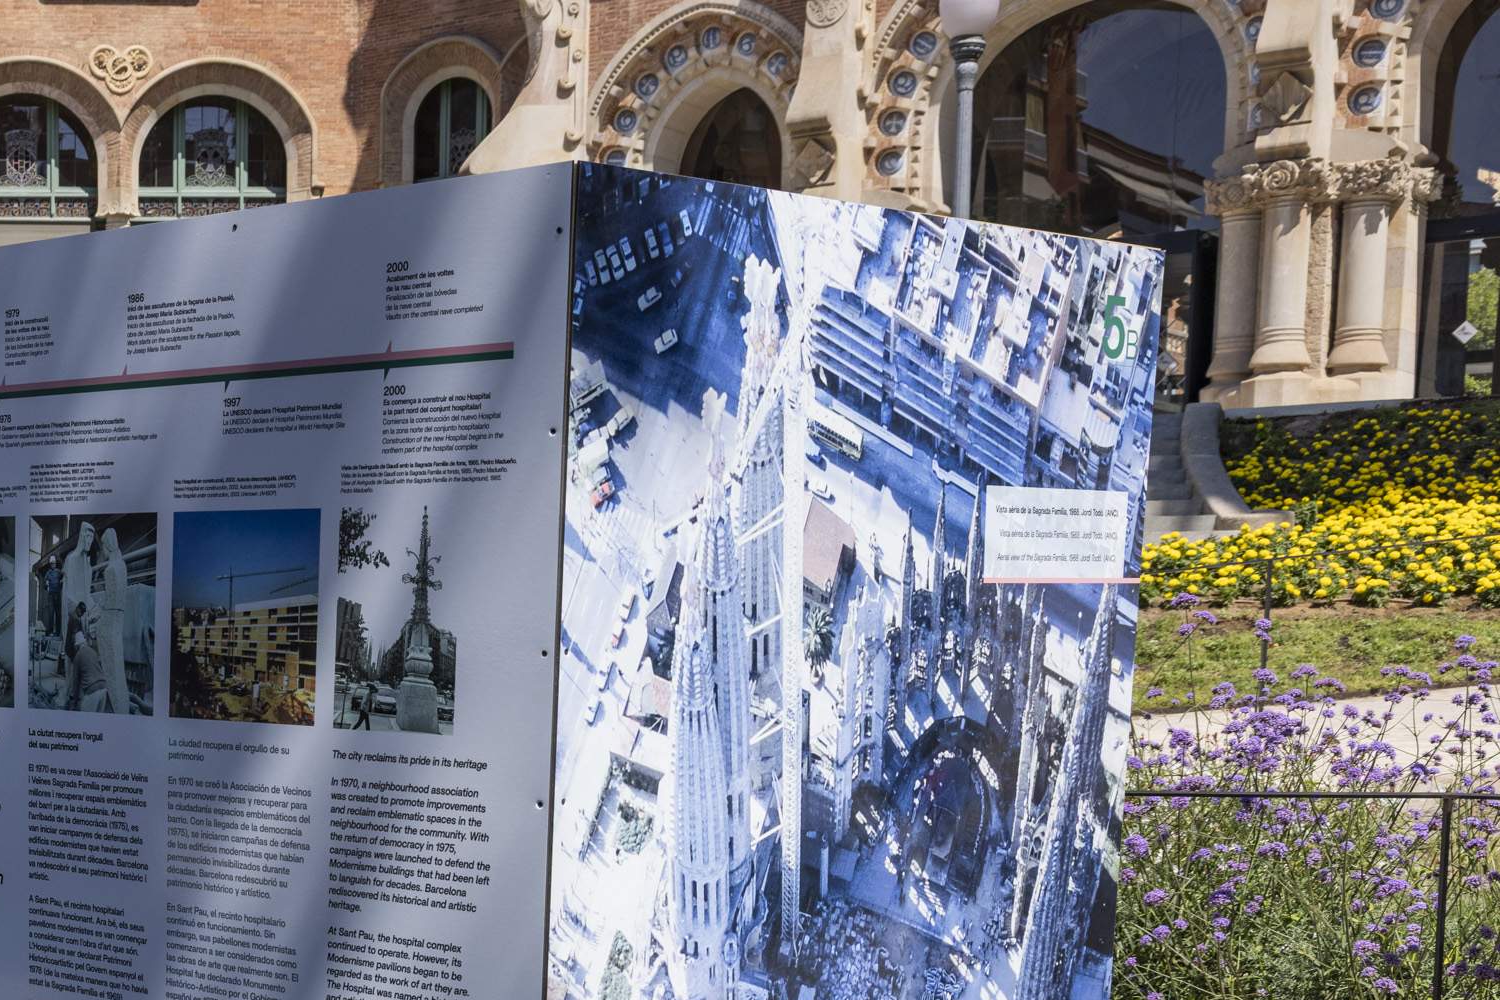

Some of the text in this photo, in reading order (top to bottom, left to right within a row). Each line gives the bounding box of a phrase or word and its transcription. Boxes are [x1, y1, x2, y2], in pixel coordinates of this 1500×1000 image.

[386, 261, 409, 273] 2000
[386, 273, 418, 282] Acabament
[437, 269, 454, 277] voltes
[412, 280, 432, 290] central
[127, 293, 145, 304] 1986
[5, 308, 20, 319] 1979
[420, 309, 439, 317] central
[453, 304, 484, 314] completed
[383, 385, 406, 396] 2000
[223, 397, 241, 407] 1997
[391, 398, 417, 406] comença
[422, 395, 447, 403] construir
[467, 392, 491, 401] Hospital
[36, 728, 54, 738] ciutat
[55, 731, 82, 741] recupera
[28, 740, 38, 748] del
[50, 742, 79, 752] patrimoni
[178, 739, 201, 748] ciudad
[203, 742, 233, 751] recupera
[243, 744, 268, 754] orgullo
[269, 744, 279, 754] de
[280, 747, 290, 755] su
[168, 752, 204, 762] patrimonio
[332, 750, 347, 759] The
[348, 752, 363, 762] city
[364, 753, 397, 763] reclaims
[398, 754, 408, 764] its
[409, 755, 431, 766] pride
[441, 757, 452, 767] its
[453, 758, 488, 772] heritage
[340, 778, 359, 790] 1970,
[368, 780, 430, 794] neighbourhood
[431, 786, 479, 798] association
[331, 793, 347, 801] was
[348, 794, 379, 804] created
[390, 798, 425, 808] promote
[426, 798, 486, 813] improvements
[330, 805, 346, 814] and
[347, 807, 376, 816] reclaim
[377, 809, 425, 822] emblematic
[426, 815, 457, 825] spaces
[468, 817, 482, 827] the
[330, 818, 489, 842] neighbourhood for the community. With
[330, 832, 343, 841] the
[344, 835, 367, 844] return
[369, 836, 378, 845] of
[379, 836, 425, 852] democracy
[436, 842, 456, 855] 1975,
